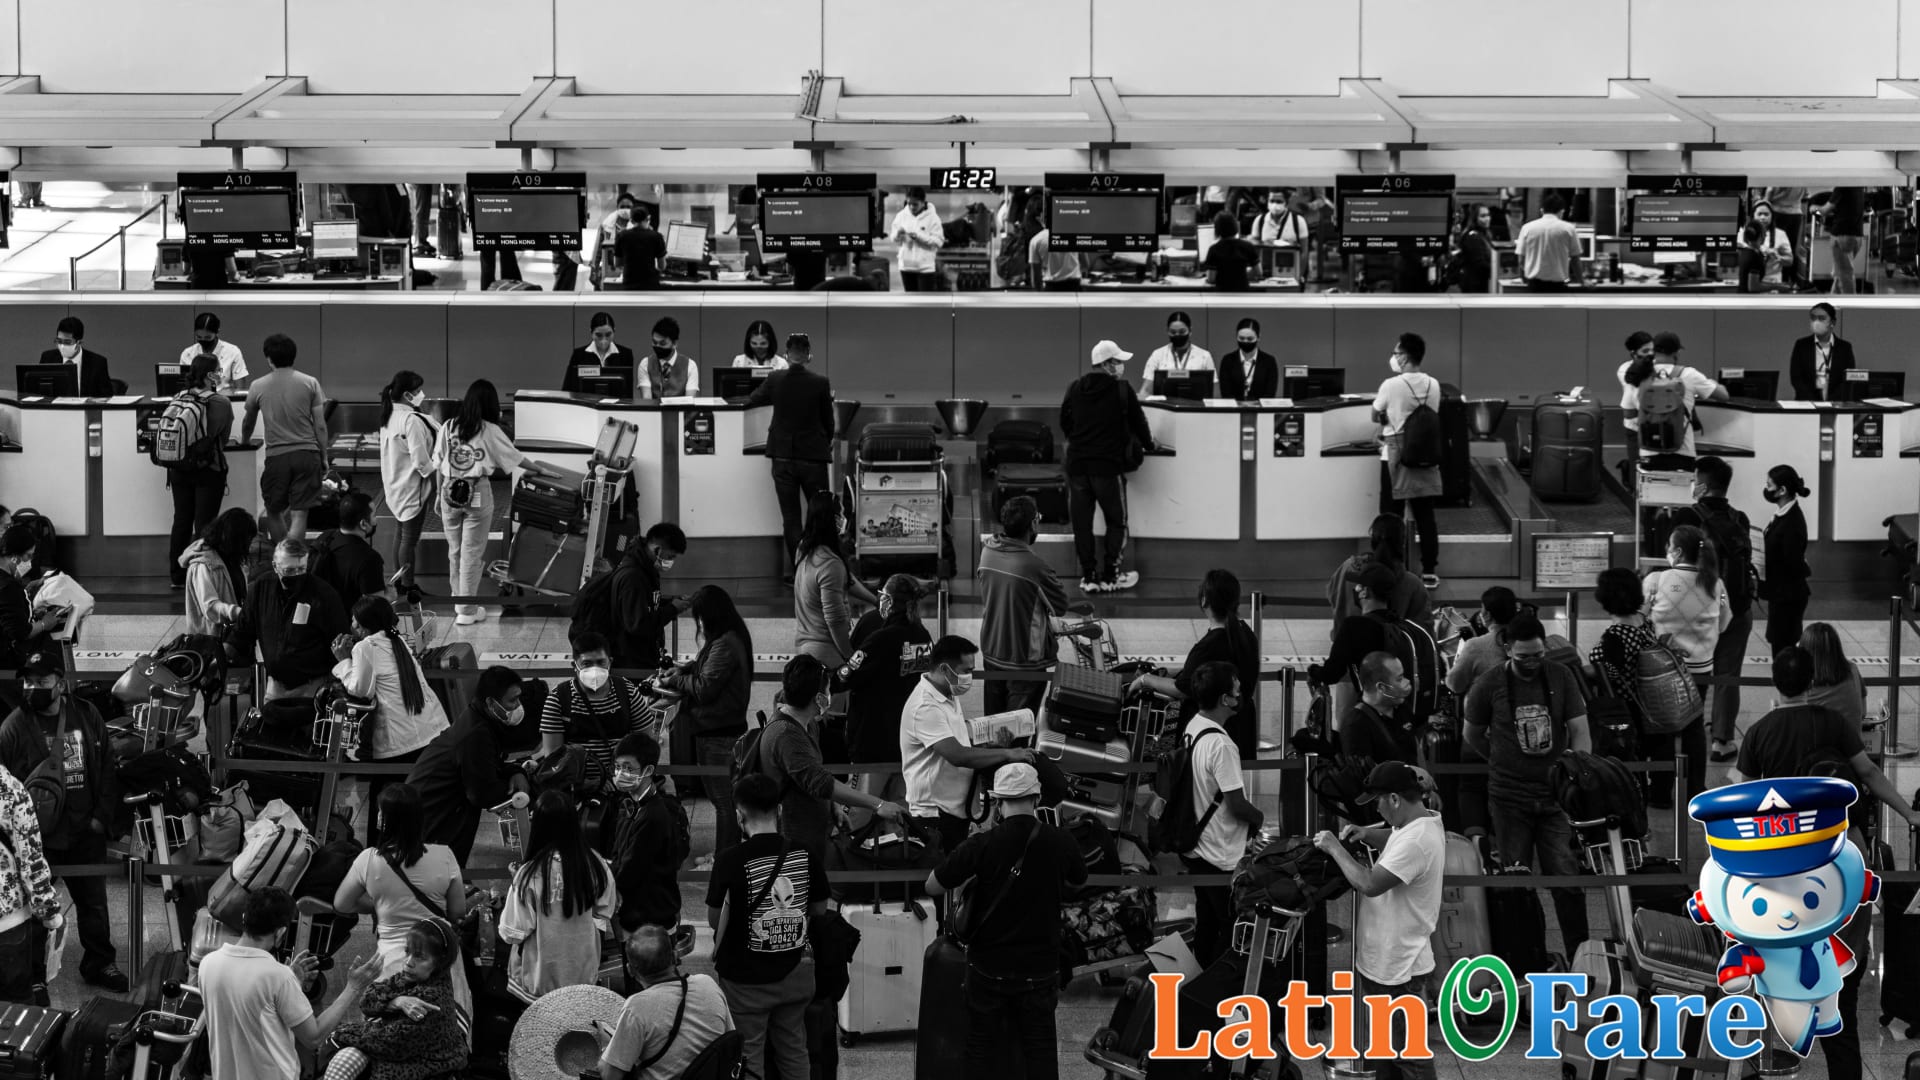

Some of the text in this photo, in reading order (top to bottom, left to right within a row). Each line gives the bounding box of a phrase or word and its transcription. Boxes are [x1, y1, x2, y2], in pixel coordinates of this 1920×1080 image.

[225, 174, 251, 185] A 10
[512, 175, 541, 185] A 09
[803, 176, 832, 186] A 08
[942, 170, 994, 188] 15:22
[1090, 176, 1119, 186] A 07
[1382, 178, 1410, 188] A 06
[1673, 178, 1702, 188] A 05
[783, 924, 798, 933] SAFE
